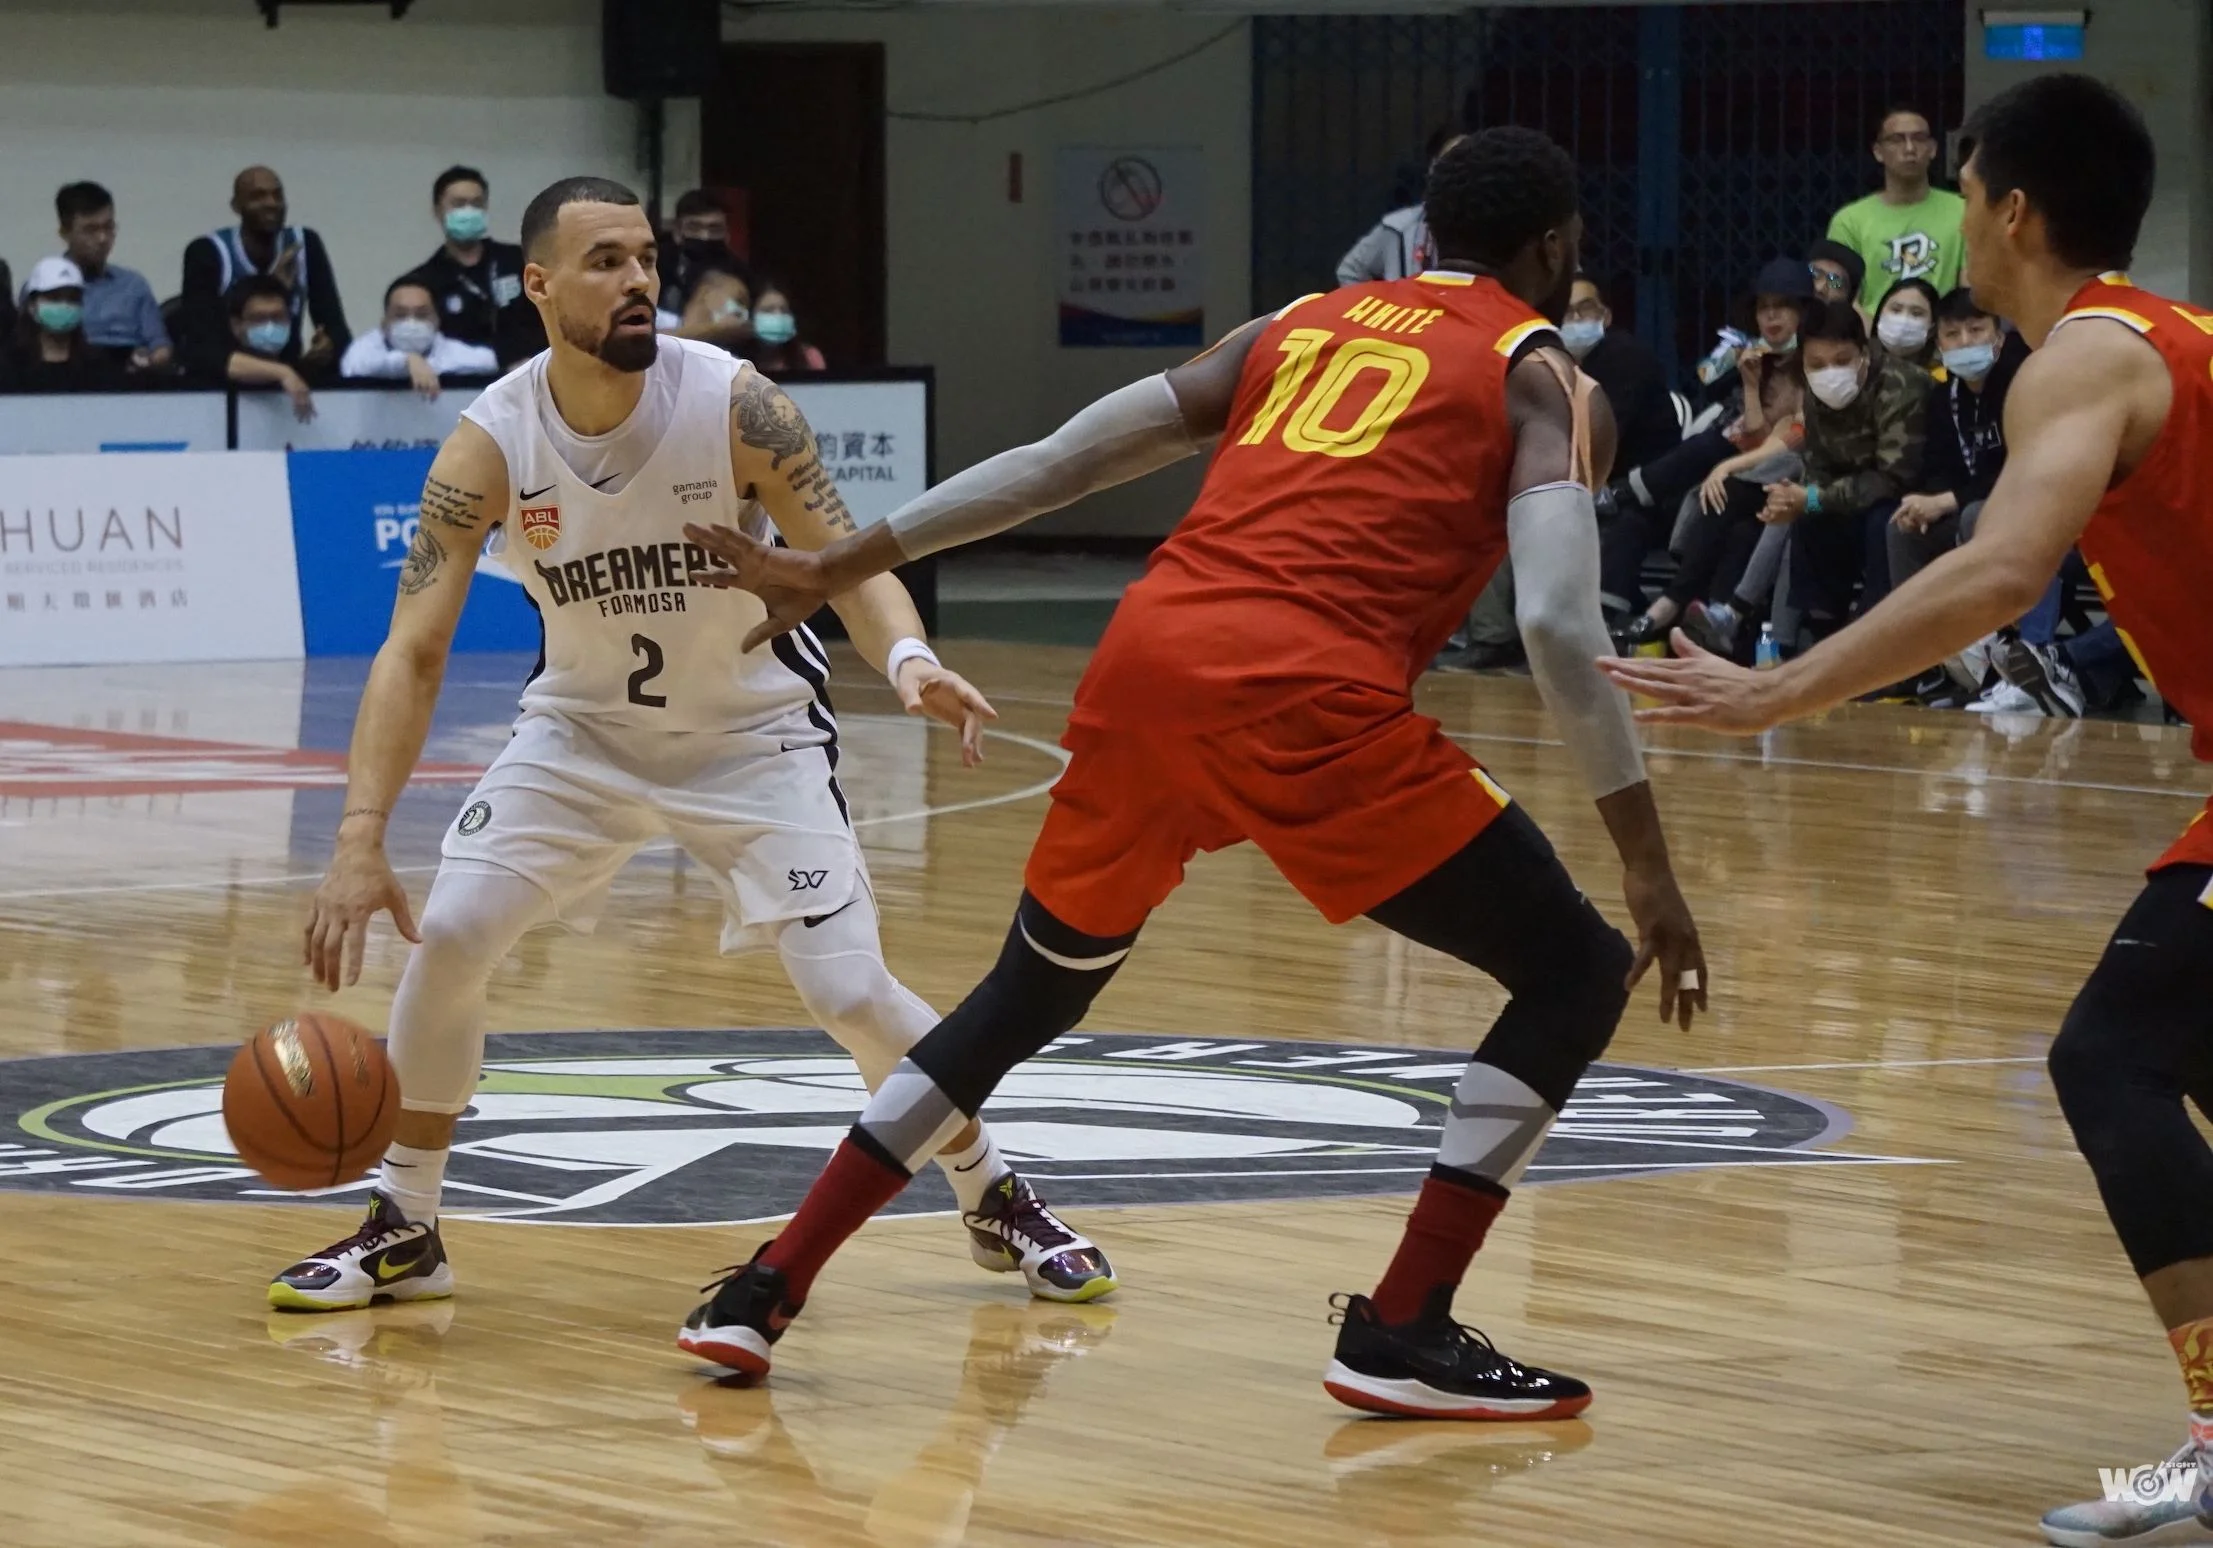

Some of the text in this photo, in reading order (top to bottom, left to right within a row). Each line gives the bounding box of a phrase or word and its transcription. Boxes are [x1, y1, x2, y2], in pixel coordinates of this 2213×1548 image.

[1343, 295, 1444, 334] WHITE
[1237, 328, 1430, 458] 10
[672, 479, 718, 496] gamania
[681, 489, 713, 504] group
[0, 505, 184, 553] HUAN
[523, 510, 559, 525] ABL
[597, 592, 687, 618] FORMOSA
[628, 633, 667, 708] 2
